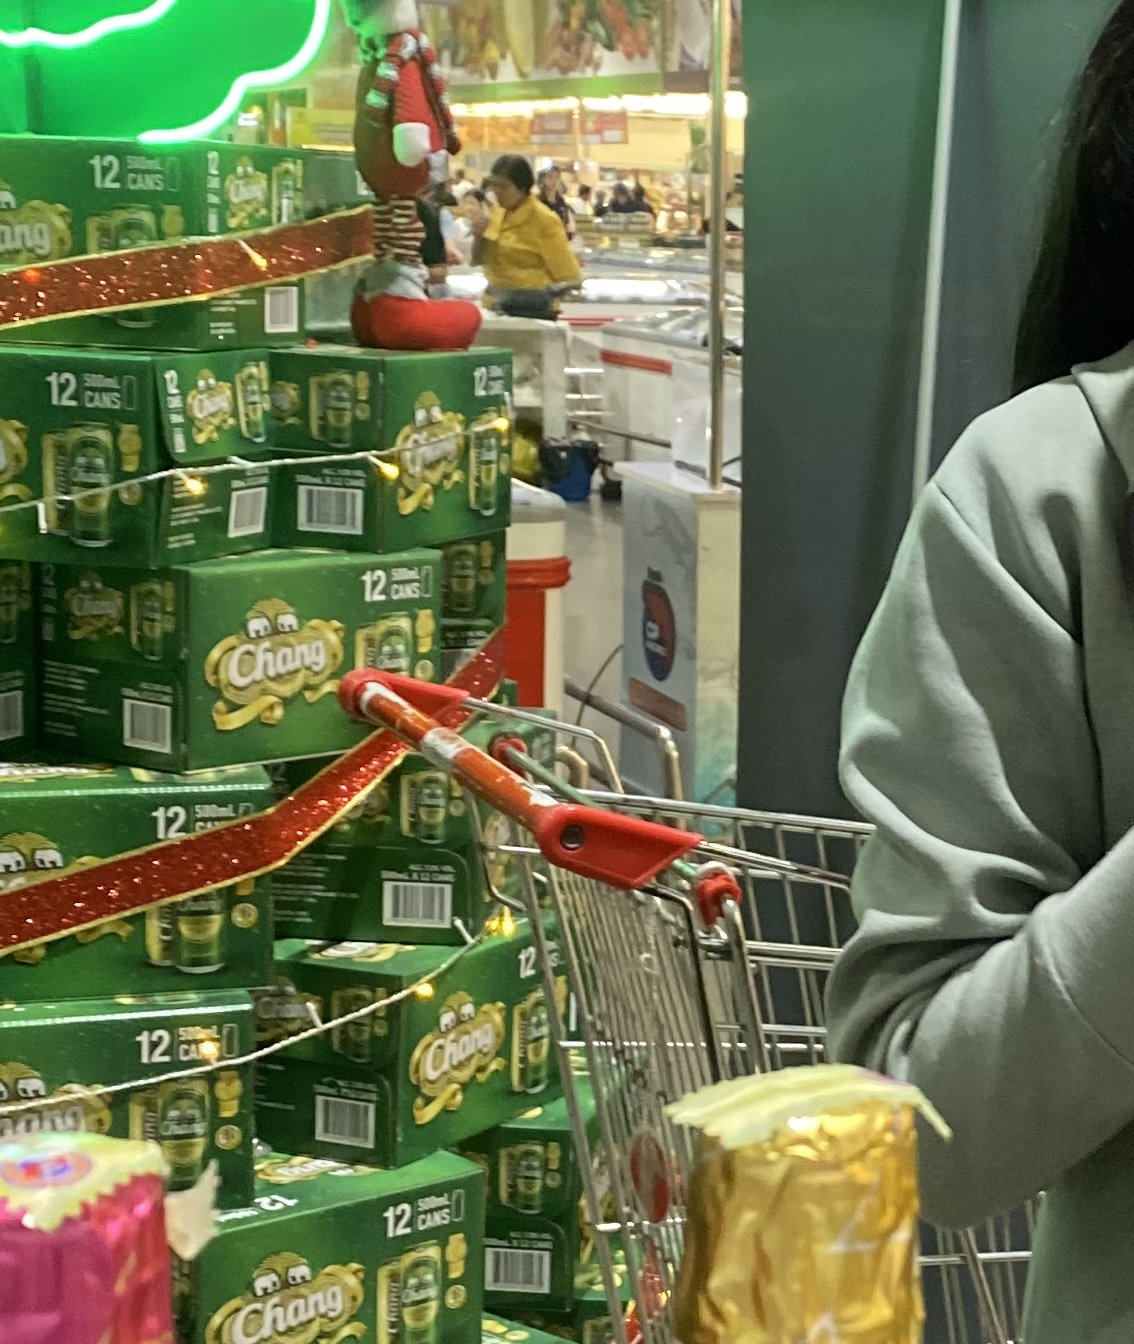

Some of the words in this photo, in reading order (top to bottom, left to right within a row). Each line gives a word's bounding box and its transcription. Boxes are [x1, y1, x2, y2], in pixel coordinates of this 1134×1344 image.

[90, 155, 121, 189] 12
[0, 223, 49, 255] ang
[47, 372, 78, 406] 12
[362, 569, 386, 602] 12
[391, 583, 420, 600] CANS
[228, 640, 326, 688] Chang
[152, 806, 187, 839] 12
[136, 1029, 171, 1064] 12
[426, 1023, 494, 1081] Chang
[383, 1203, 411, 1238] 12
[417, 1208, 450, 1231] CANS
